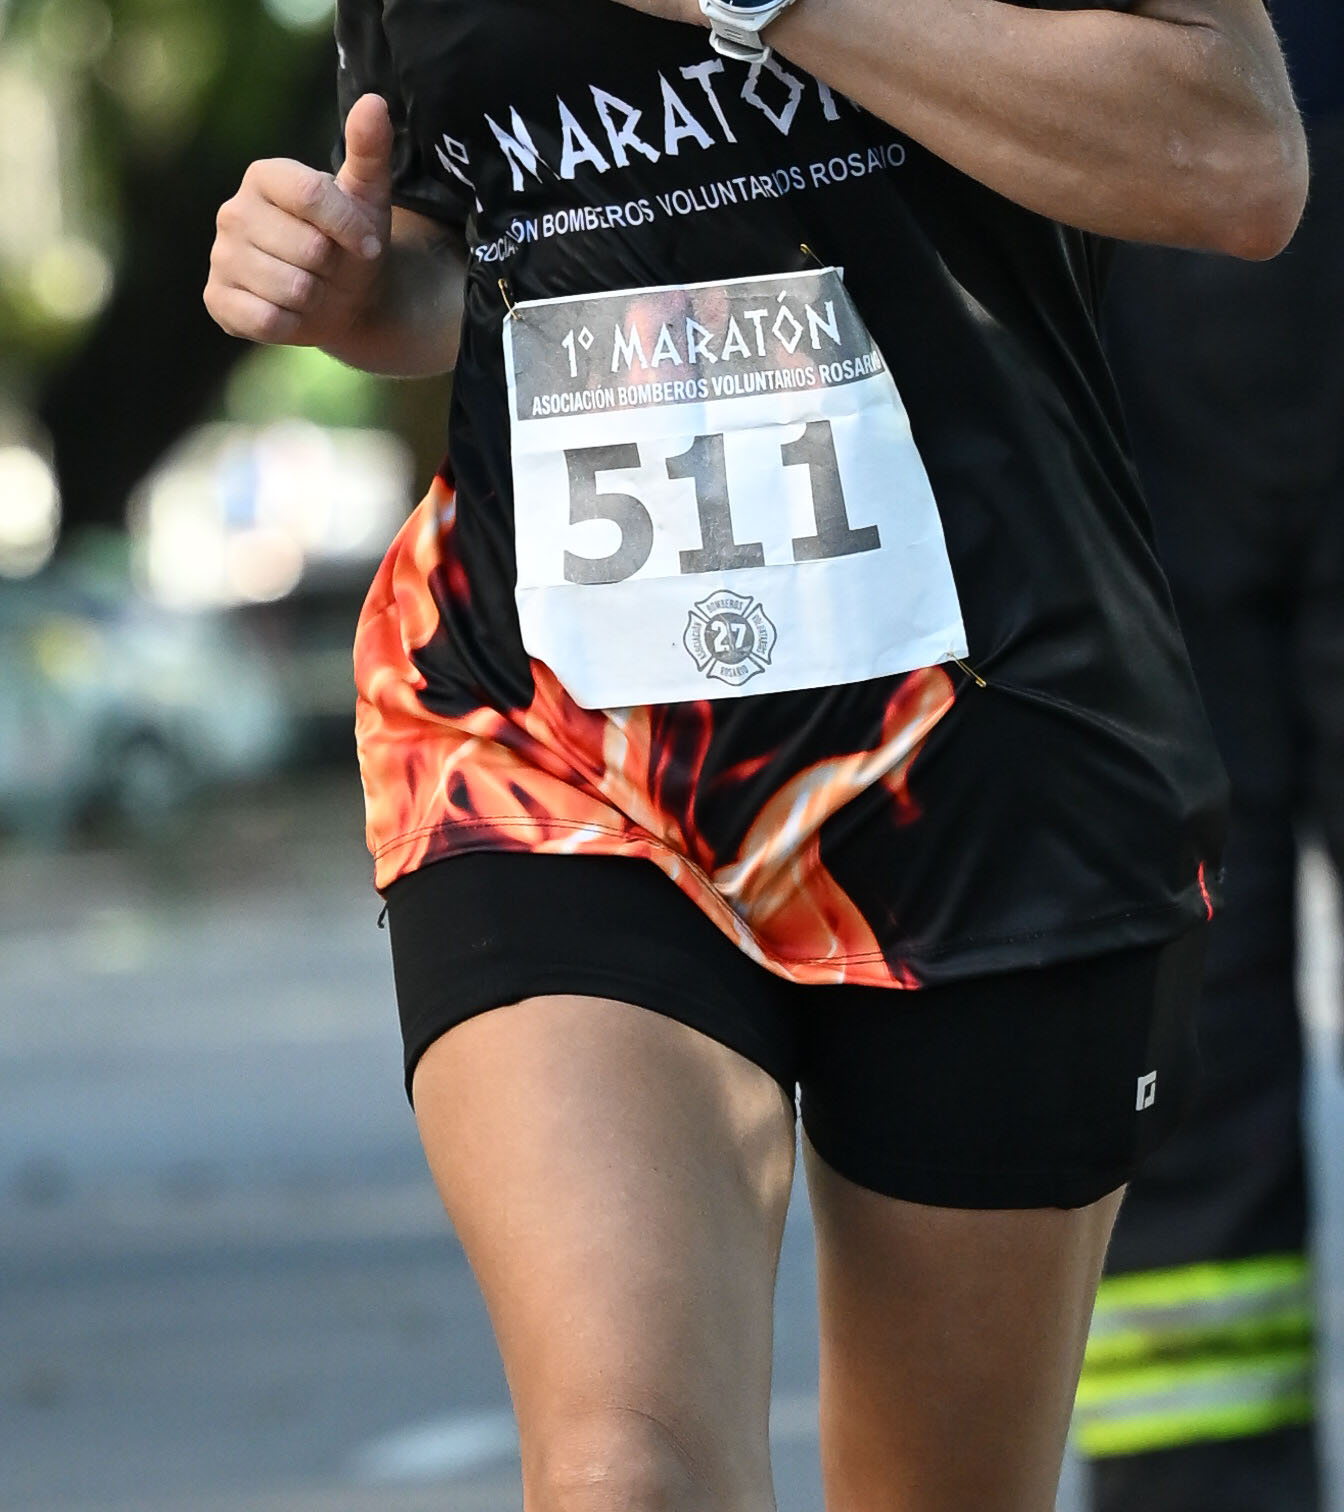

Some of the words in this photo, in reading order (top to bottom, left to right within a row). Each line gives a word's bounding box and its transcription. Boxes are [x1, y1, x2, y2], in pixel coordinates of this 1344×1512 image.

[542, 199, 655, 238] BOMBEROS
[656, 166, 806, 217] VOLUNTARIOS
[809, 143, 906, 188] ROSAIO
[610, 290, 843, 374] MARATÓN
[531, 382, 616, 416] ASOCIACIÓN
[618, 377, 709, 407] BOMBEROS
[711, 366, 816, 396] VOLUNTARIOS
[562, 419, 882, 585] 511
[705, 598, 744, 614] BOMBEROS
[710, 620, 747, 653] 27
[720, 664, 749, 678] ROSARIO
